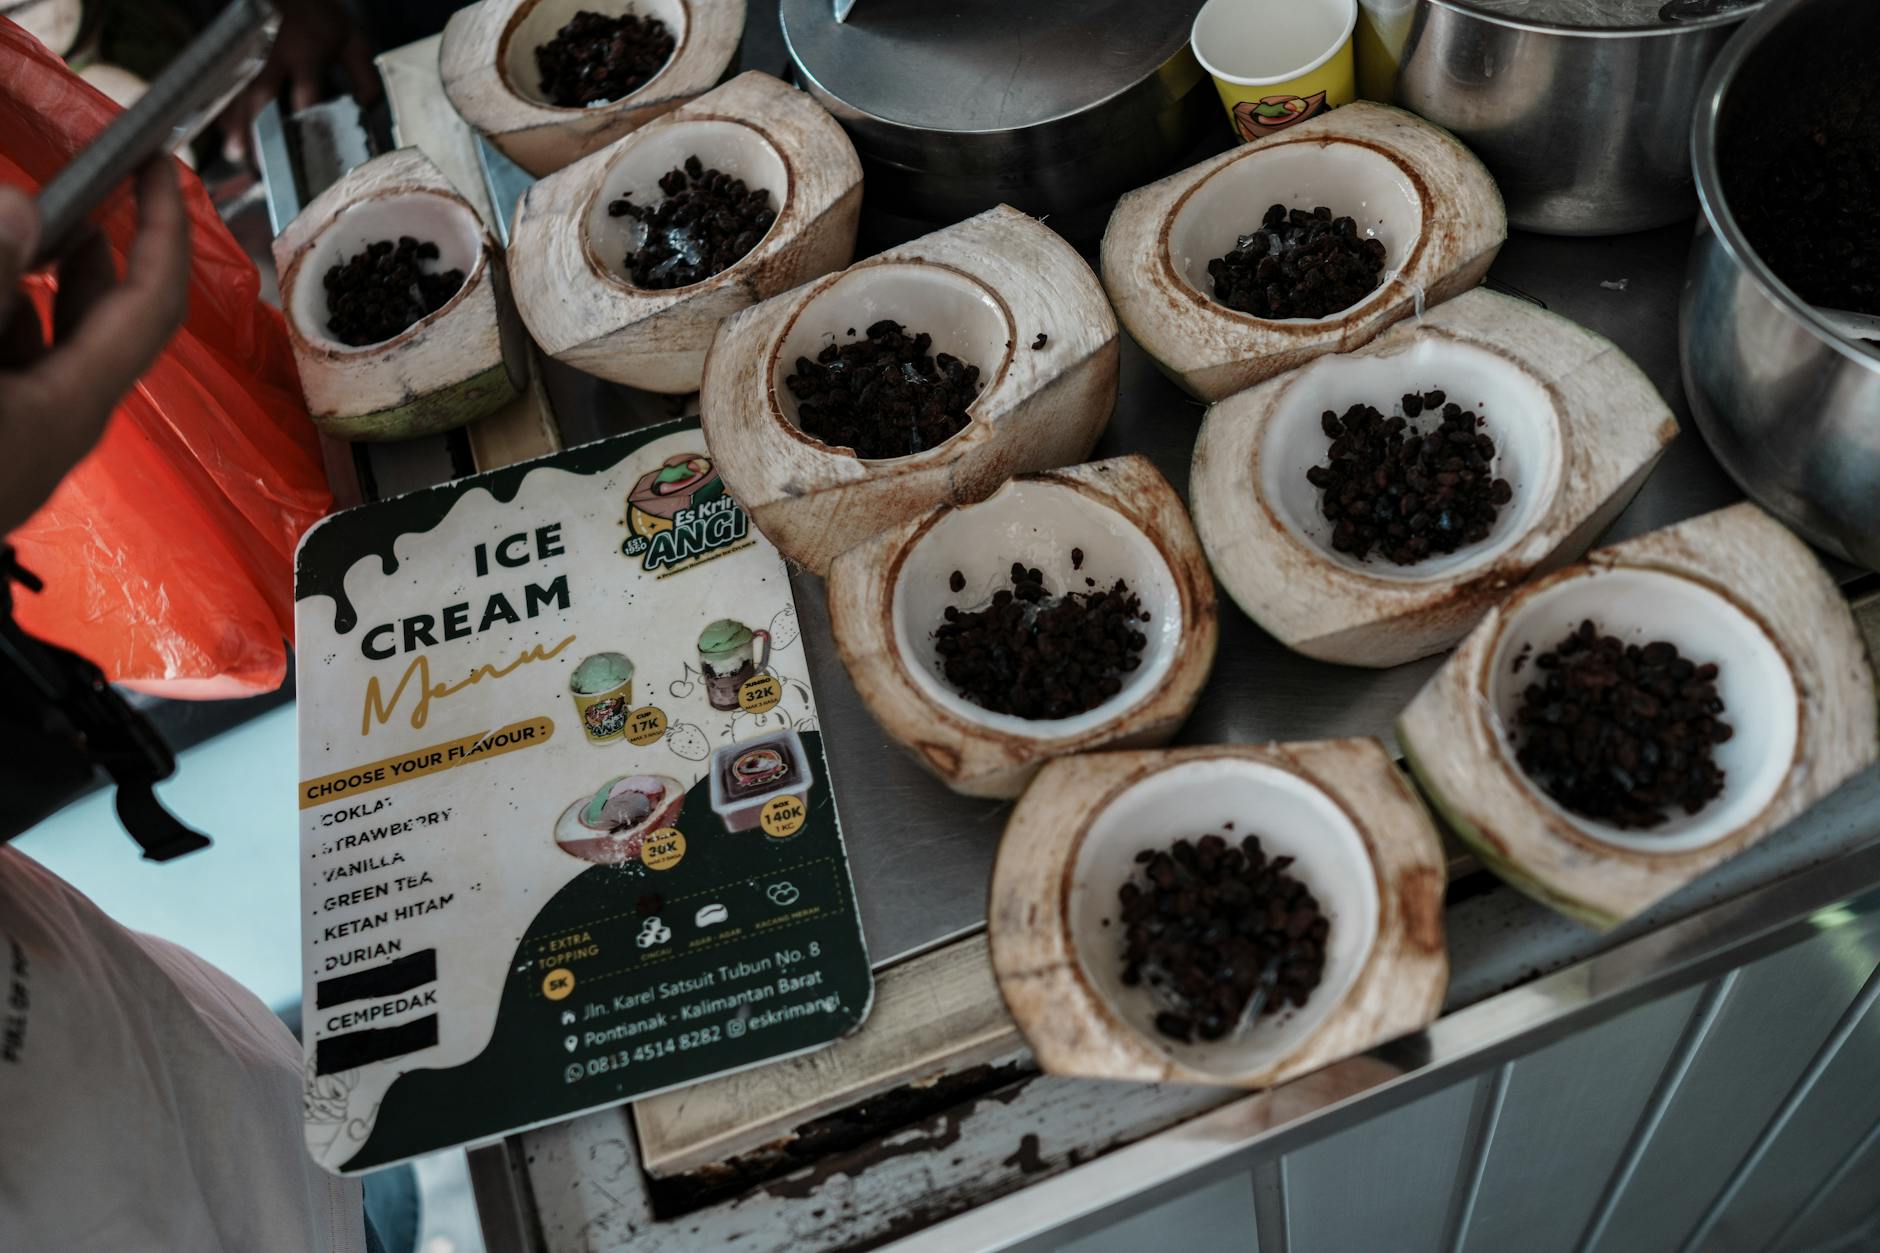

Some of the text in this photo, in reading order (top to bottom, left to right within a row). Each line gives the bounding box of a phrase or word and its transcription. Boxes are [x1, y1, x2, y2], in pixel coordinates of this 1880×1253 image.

[676, 510, 696, 527] Es
[474, 522, 566, 578] ICE
[625, 542, 647, 555] 1950
[644, 506, 746, 570] ANGI
[361, 574, 571, 661] CREAM
[361, 634, 577, 736] Menu
[746, 686, 774, 702] 32K
[632, 717, 659, 734] 17K
[636, 711, 652, 720] CUP
[307, 768, 386, 799] CHOOSE
[391, 751, 442, 776] YOUR
[448, 726, 536, 761] FLAVOUR
[764, 805, 802, 825] 140K
[773, 800, 790, 809] BOX
[323, 852, 406, 882] VANILLA
[324, 871, 433, 912] GREEN TEA
[324, 893, 455, 942] KETAN HITAM
[755, 914, 790, 930] KACANG
[550, 931, 592, 951] EXTRA
[689, 935, 713, 948] AGAR
[719, 927, 743, 940] AGAR
[325, 939, 402, 972] DURIAN
[538, 944, 600, 969] TOPPING
[640, 948, 673, 962] CINCAU
[549, 977, 569, 991] 5K
[583, 940, 821, 1020] Jln. Karel Satsuit Tubun No. 8
[327, 989, 437, 1032] CEMPEDAK
[584, 1012, 667, 1047] Pontianak
[681, 985, 774, 1020] Kalimantan
[777, 970, 823, 994] Barat
[586, 990, 840, 1076] 0813 4514 8282 eskrimangi
